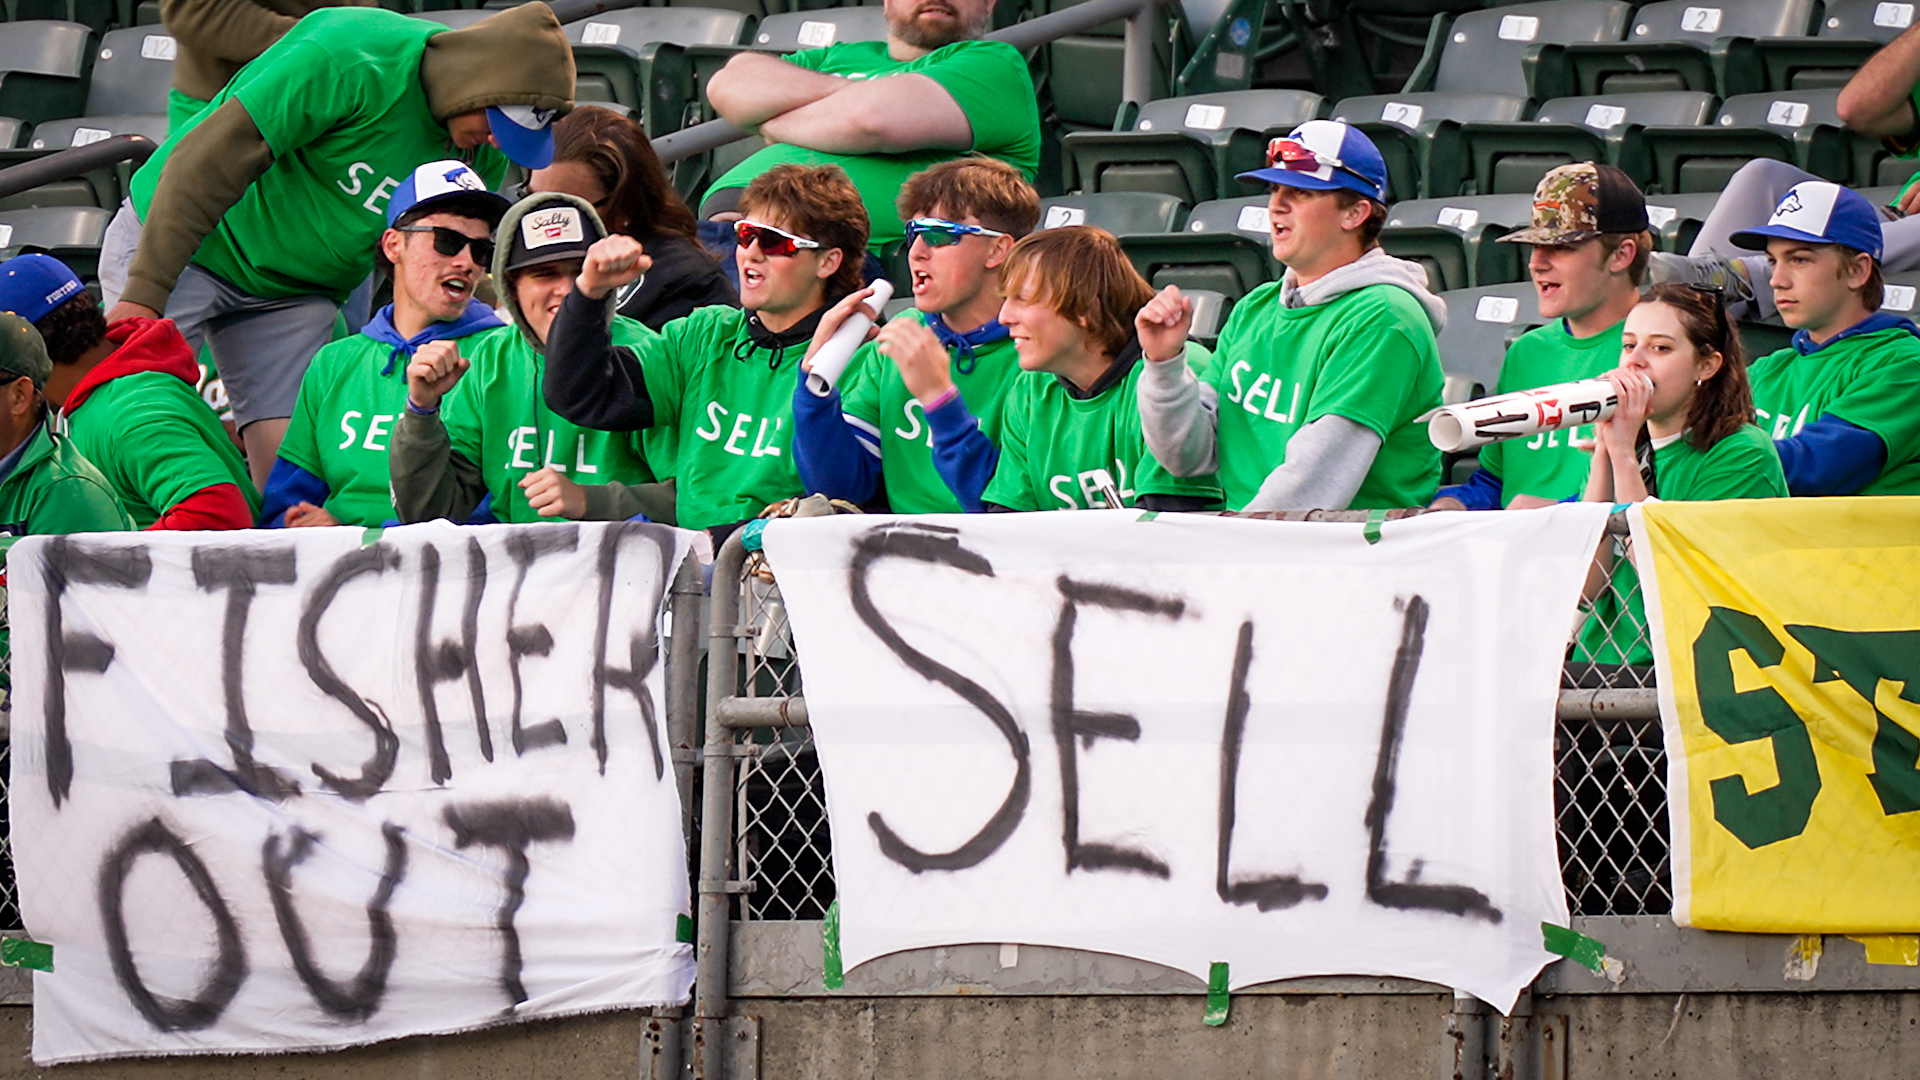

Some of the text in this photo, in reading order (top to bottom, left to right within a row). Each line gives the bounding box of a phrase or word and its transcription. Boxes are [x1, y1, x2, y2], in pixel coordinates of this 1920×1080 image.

[1694, 11, 1708, 30] 2
[1886, 6, 1900, 26] 3
[592, 25, 611, 43] 14
[810, 24, 827, 44] 15
[153, 40, 170, 57] 12
[1597, 109, 1611, 127] 3
[1781, 105, 1794, 124] 4
[336, 162, 401, 216] SE
[1059, 210, 1073, 227] 2
[1251, 212, 1264, 230] 3
[1887, 287, 1901, 308] 8
[1490, 301, 1503, 318] 6
[338, 410, 404, 451] SE
[42, 520, 677, 810] FISHER
[849, 521, 1505, 924] SELL
[100, 796, 577, 1032] OUT
